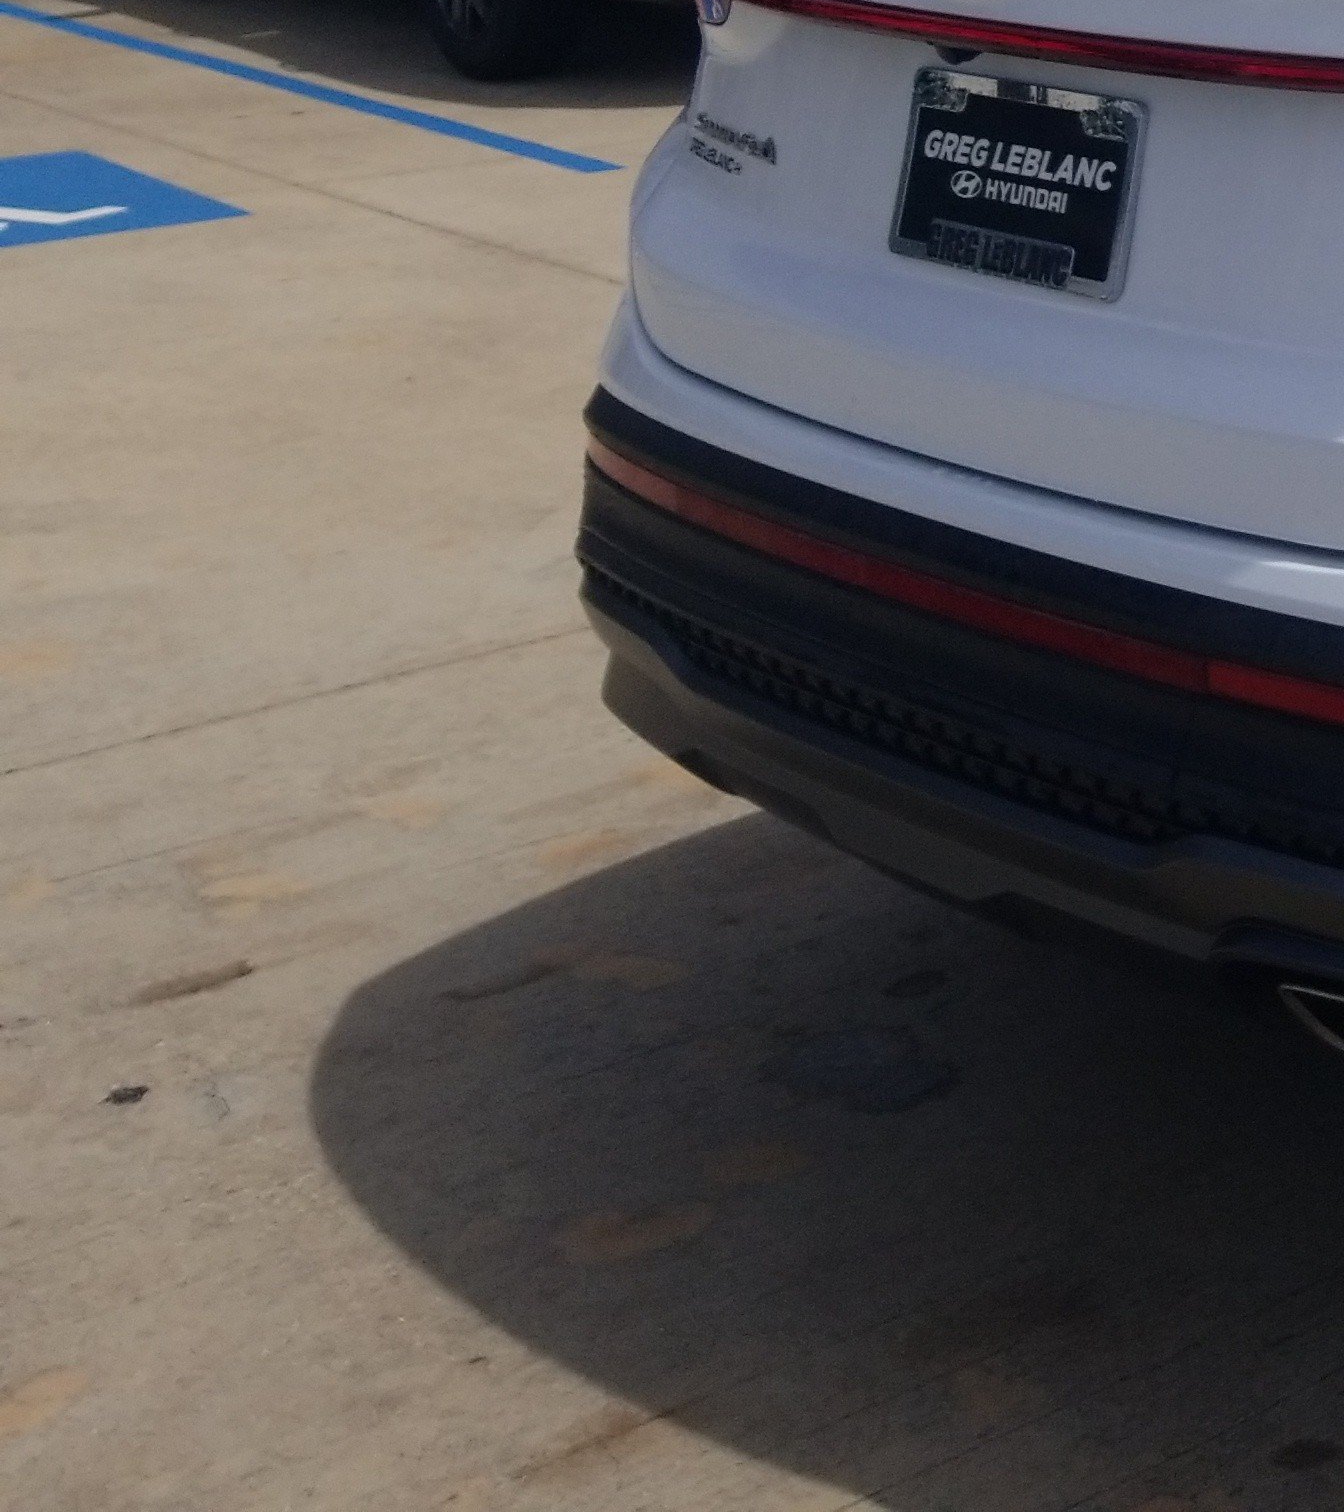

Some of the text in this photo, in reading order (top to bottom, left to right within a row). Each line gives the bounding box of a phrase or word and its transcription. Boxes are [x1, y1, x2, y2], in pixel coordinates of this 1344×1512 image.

[923, 129, 1117, 191] GREG LEBLANC
[984, 177, 1068, 214] HYUNDAI
